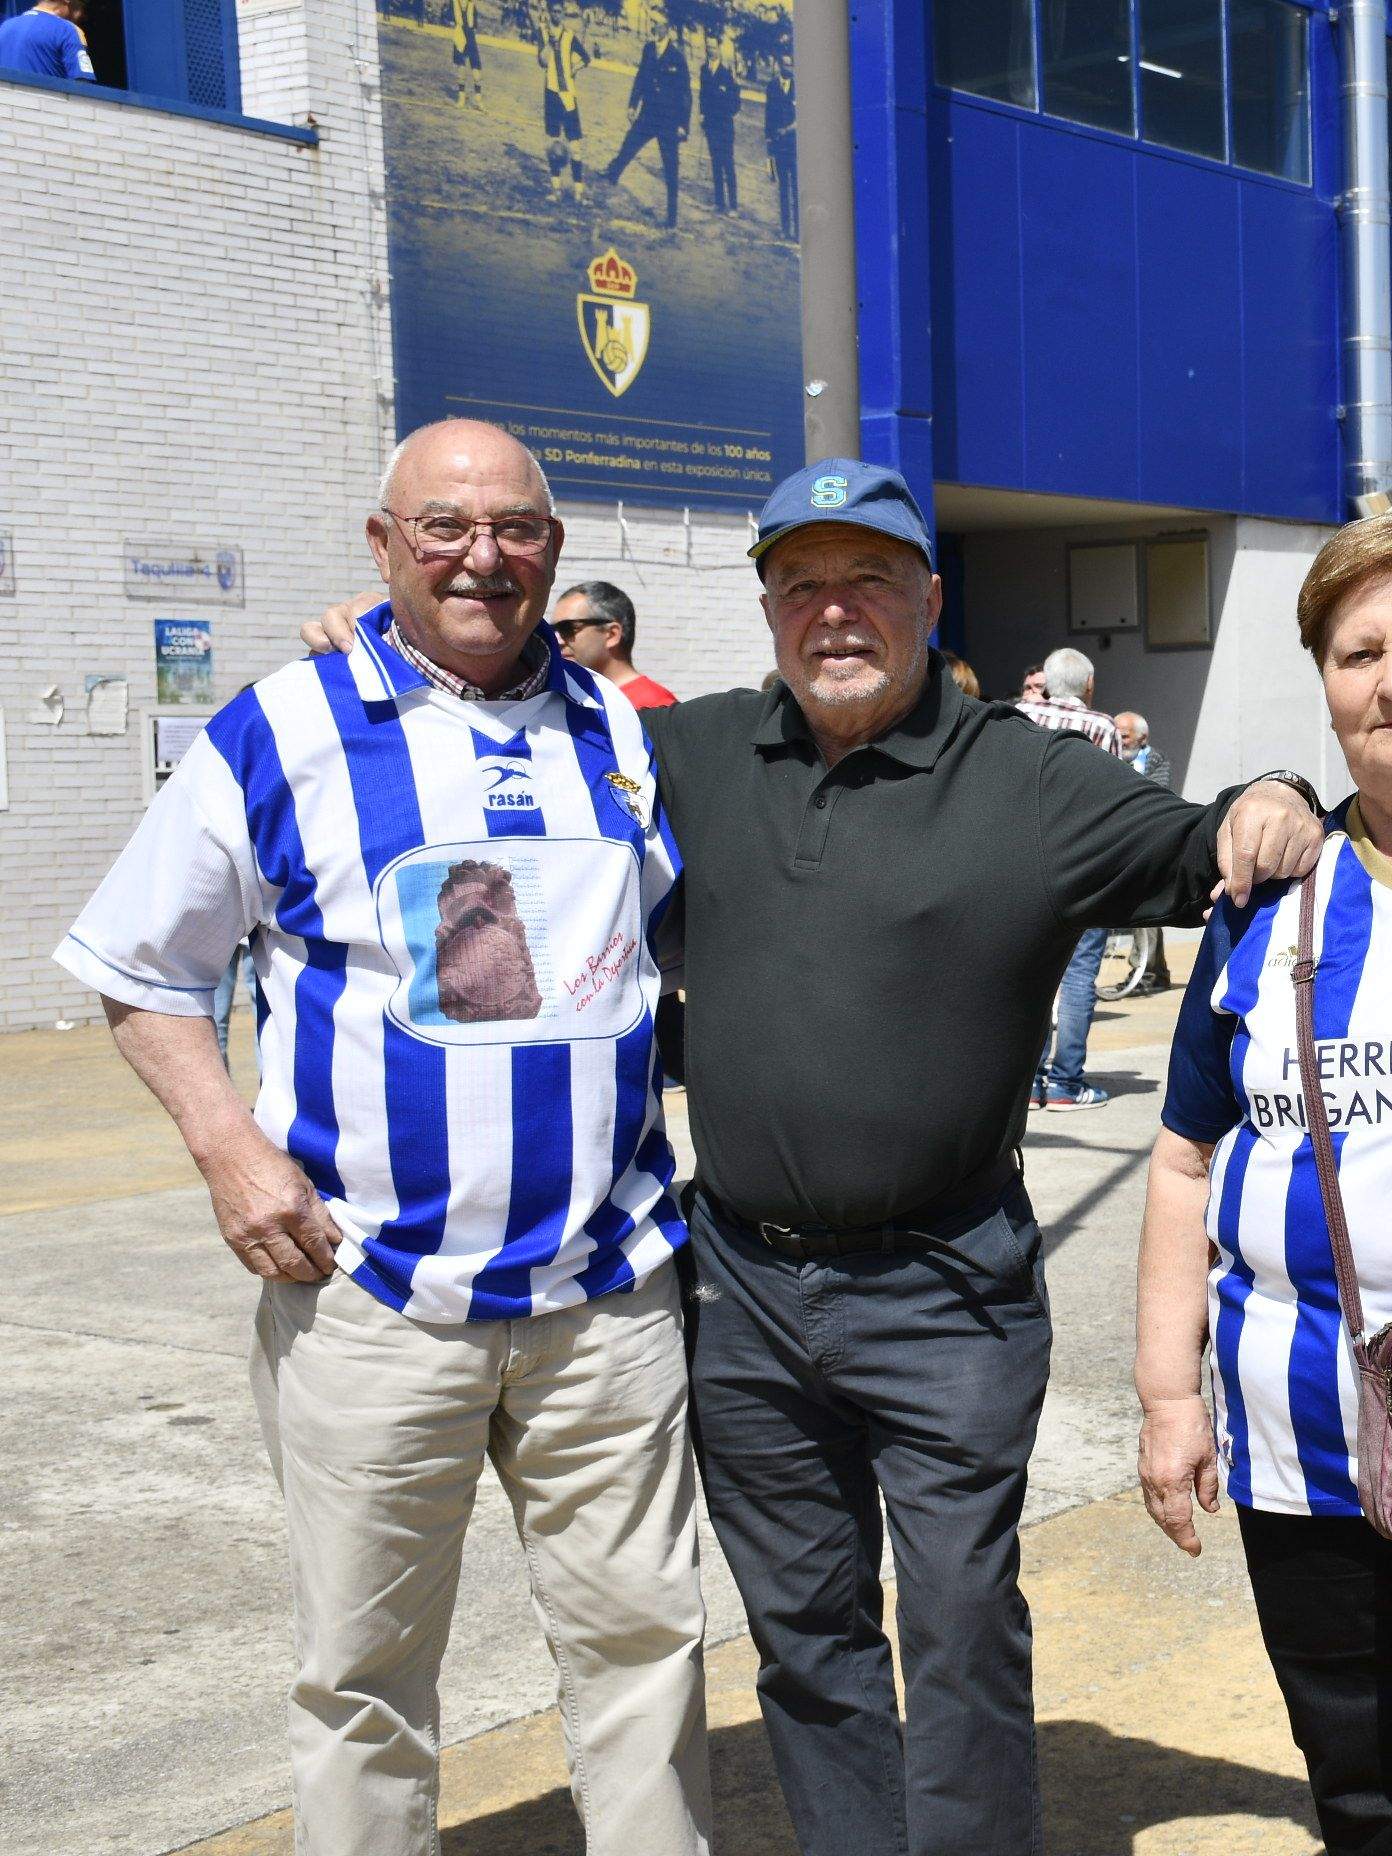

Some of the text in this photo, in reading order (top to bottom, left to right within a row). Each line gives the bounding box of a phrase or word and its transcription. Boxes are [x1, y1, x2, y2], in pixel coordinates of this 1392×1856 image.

[528, 424, 593, 443] momentos
[595, 432, 619, 446] más
[622, 433, 689, 453] importantes
[691, 442, 705, 454] de
[707, 443, 723, 457] los
[724, 444, 744, 458] 100
[745, 446, 772, 462] años
[544, 447, 563, 462] SD
[565, 449, 641, 470] Ponferradina
[643, 459, 659, 471] en
[660, 461, 684, 474] esta
[685, 464, 740, 480] exposición
[810, 475, 848, 508] S
[488, 790, 534, 806] rasán
[562, 972, 588, 996] Los
